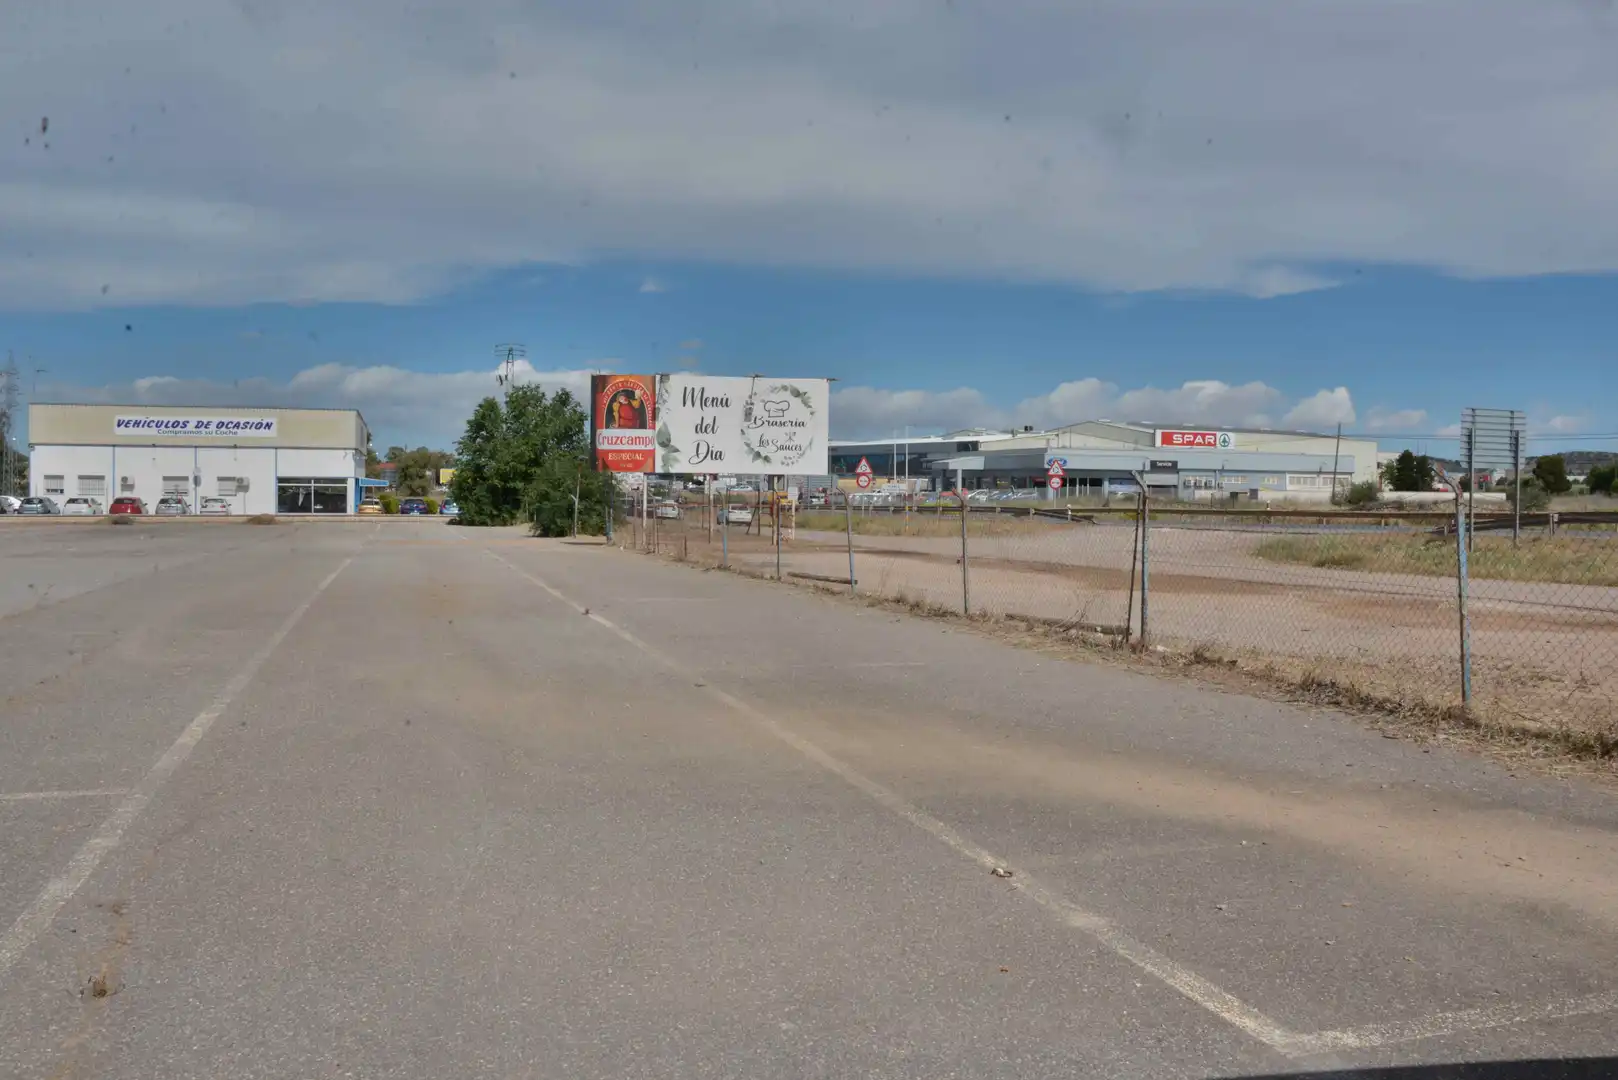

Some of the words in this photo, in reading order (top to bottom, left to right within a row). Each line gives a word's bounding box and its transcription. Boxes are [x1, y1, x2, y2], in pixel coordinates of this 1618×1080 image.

[682, 386, 731, 411] Menú
[116, 417, 190, 429] VEHÍCULOS
[194, 420, 213, 429] DE
[216, 418, 273, 430] OCASIÓN
[694, 415, 719, 434] del
[157, 428, 203, 436] Compramos
[597, 432, 655, 448] Cruzcampo
[767, 439, 803, 454] Sauces
[1172, 434, 1215, 445] SPAR
[608, 452, 645, 461] ESPECIAL
